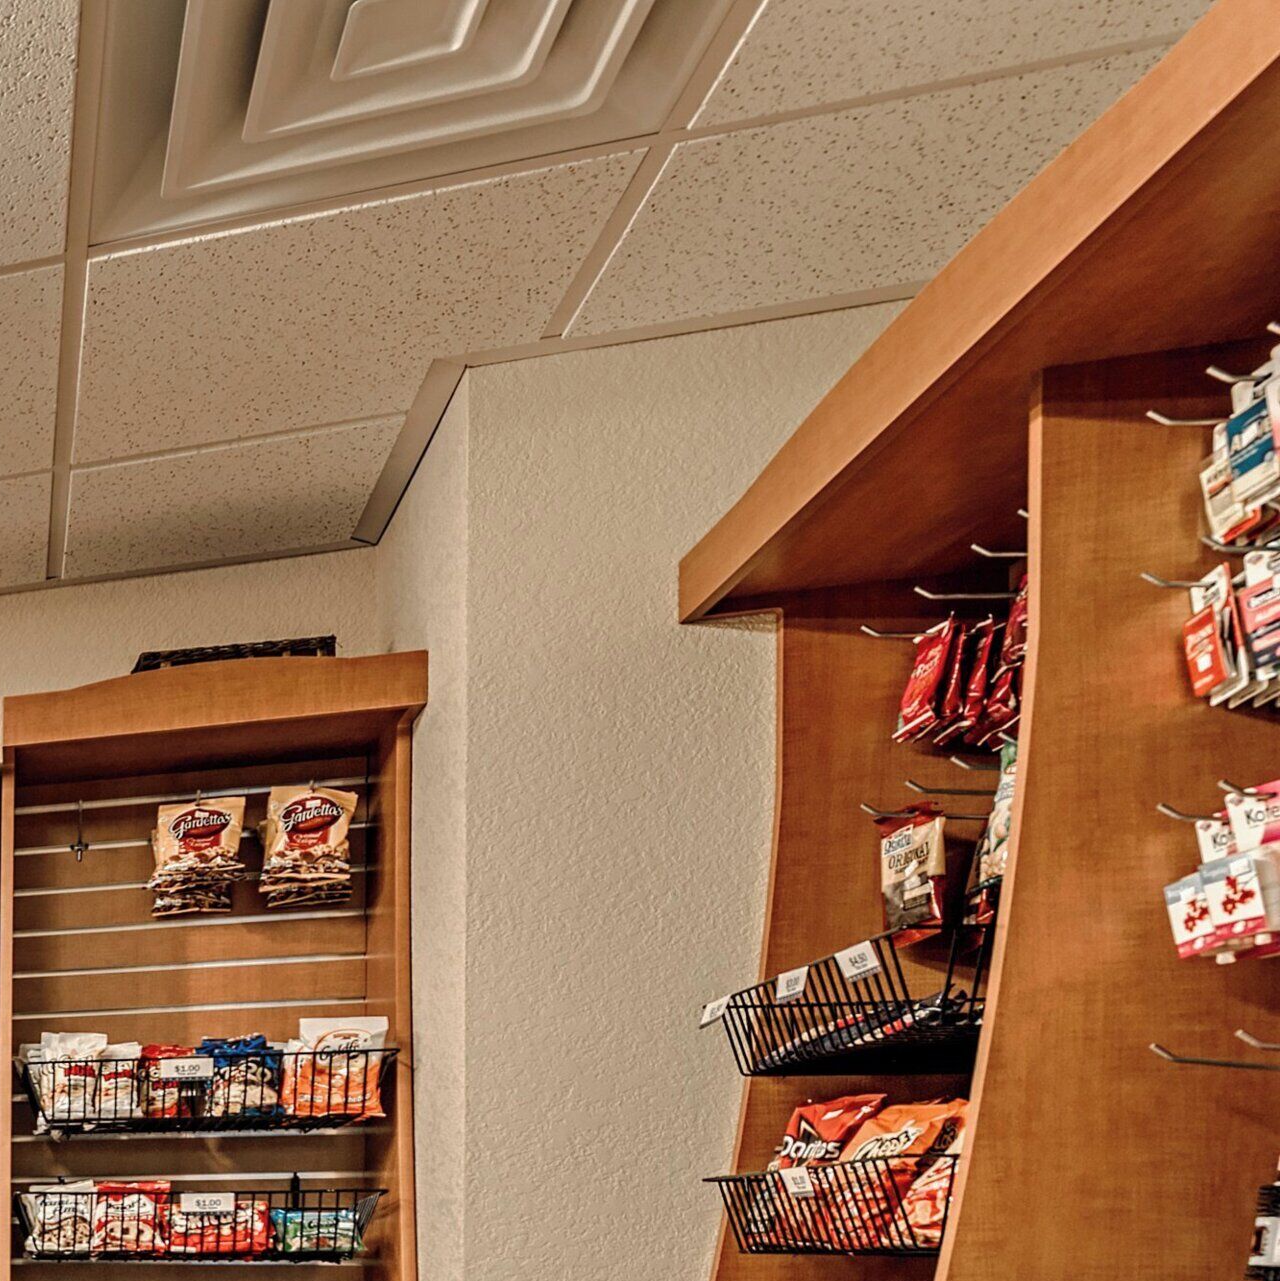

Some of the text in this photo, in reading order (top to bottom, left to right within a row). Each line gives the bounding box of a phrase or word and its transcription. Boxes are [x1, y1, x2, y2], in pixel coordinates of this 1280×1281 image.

[174, 1064, 200, 1074] $1.00
[774, 1135, 841, 1160] Doritos
[195, 1198, 222, 1207] $1.00
